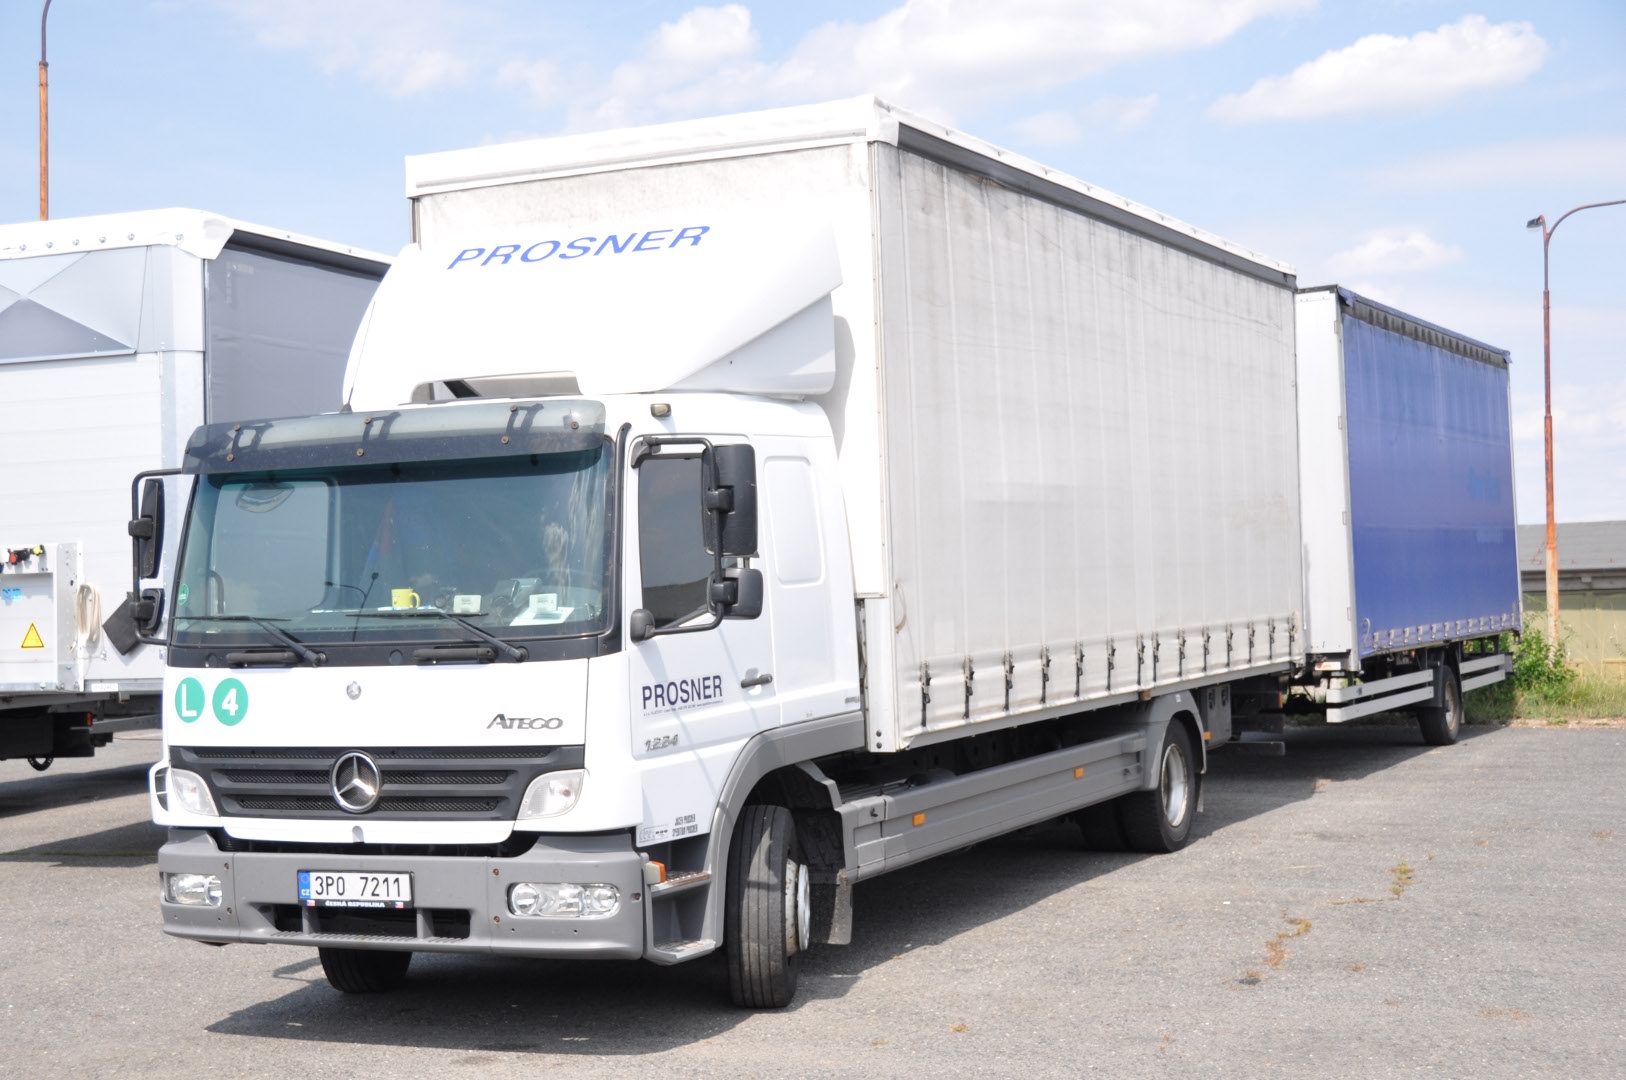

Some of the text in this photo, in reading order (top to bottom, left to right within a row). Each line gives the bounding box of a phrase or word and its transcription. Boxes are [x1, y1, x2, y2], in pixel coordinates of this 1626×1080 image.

[447, 225, 711, 270] PROSNER
[181, 683, 198, 717] L
[221, 687, 239, 717] 4
[642, 675, 723, 710] PROSNER
[486, 713, 564, 730] ATEGO
[645, 734, 679, 752] 1224
[301, 888, 311, 896] CZ
[360, 877, 400, 898] 7211
